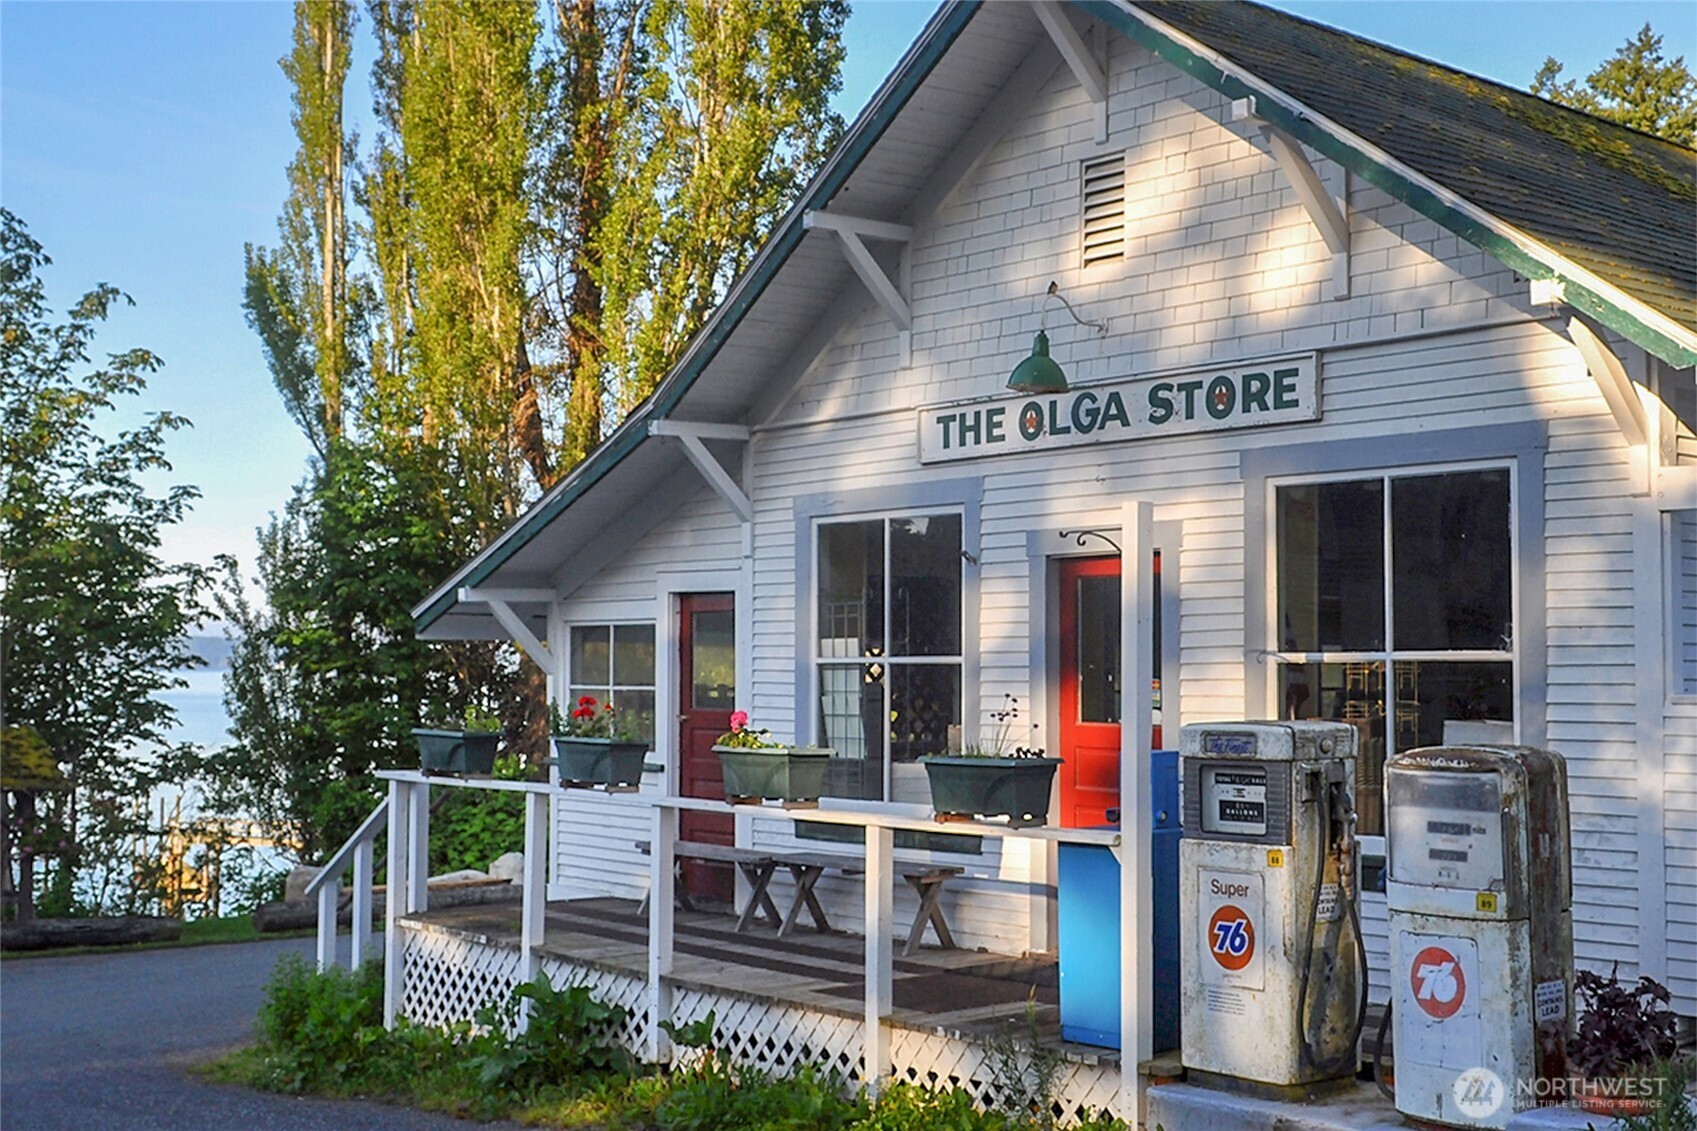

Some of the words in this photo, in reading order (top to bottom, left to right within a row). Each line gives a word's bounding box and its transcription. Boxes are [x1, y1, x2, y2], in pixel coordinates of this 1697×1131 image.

[936, 406, 1006, 450] THE
[1018, 391, 1131, 442] OLGA
[1147, 367, 1300, 425] STORE
[1211, 879, 1249, 898] Super
[1214, 920, 1249, 956] 76
[1417, 961, 1459, 1004] 76
[1541, 1005, 1560, 1017] LEAD
